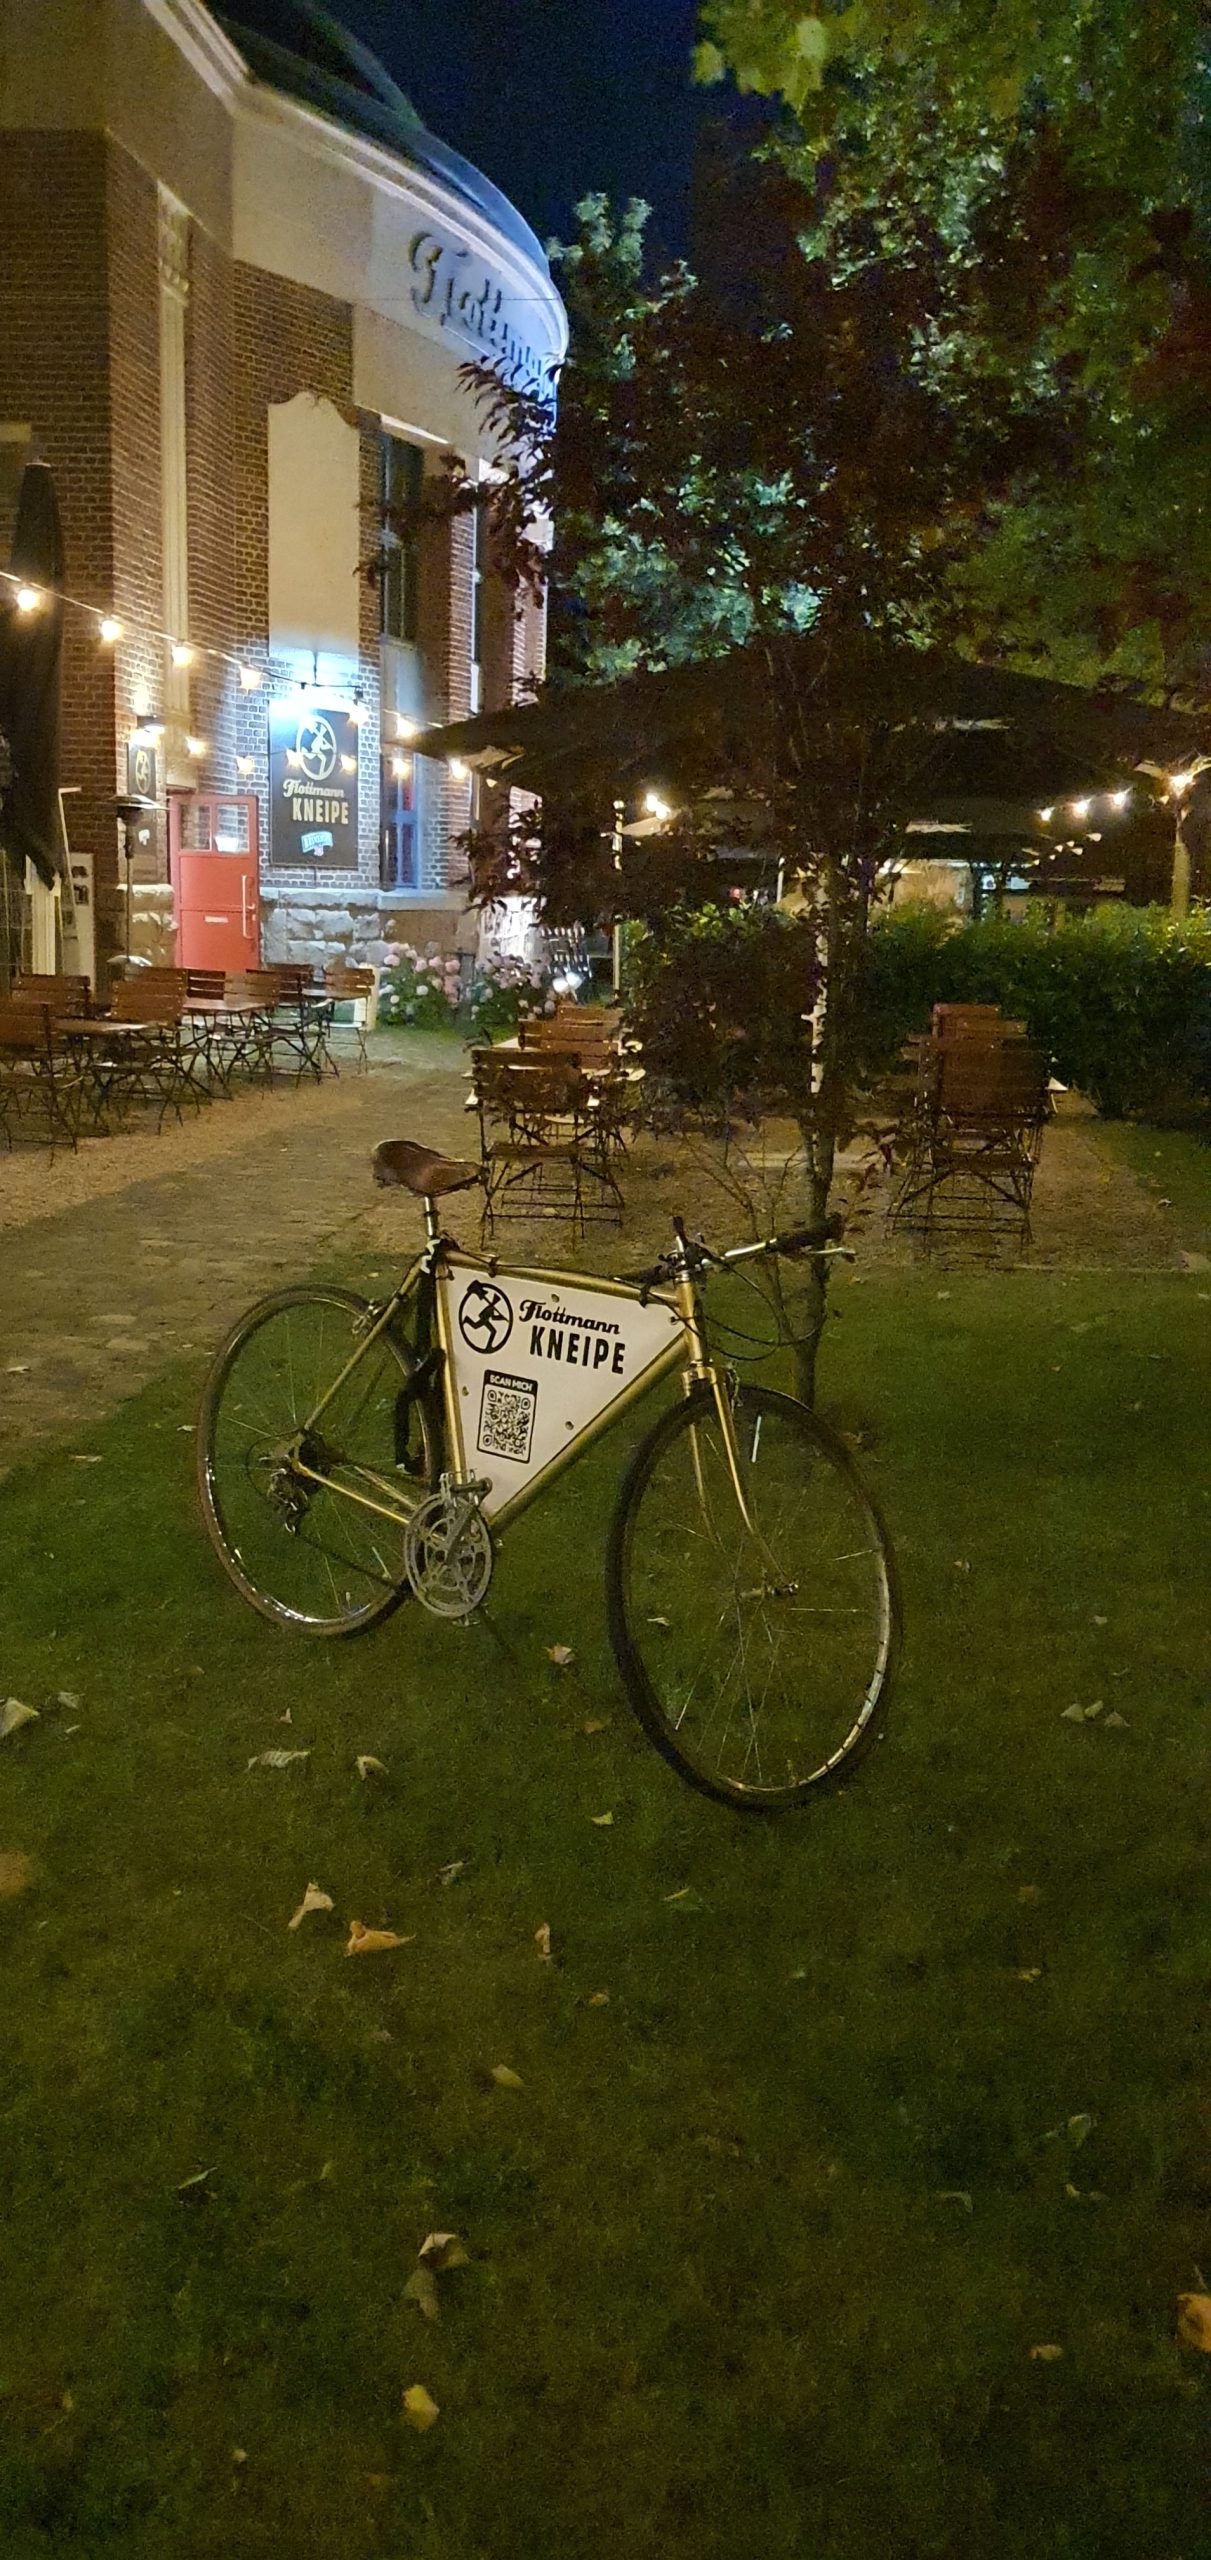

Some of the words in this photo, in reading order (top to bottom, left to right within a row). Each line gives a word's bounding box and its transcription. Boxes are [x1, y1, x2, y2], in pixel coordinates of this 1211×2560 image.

[283, 779, 345, 798] Flottmann
[292, 797, 349, 824] KNEIPE
[519, 1299, 620, 1334] Flottmann
[529, 1324, 625, 1374] KNEIPE
[489, 1374, 512, 1387] SCAN
[511, 1379, 533, 1392] MICH
